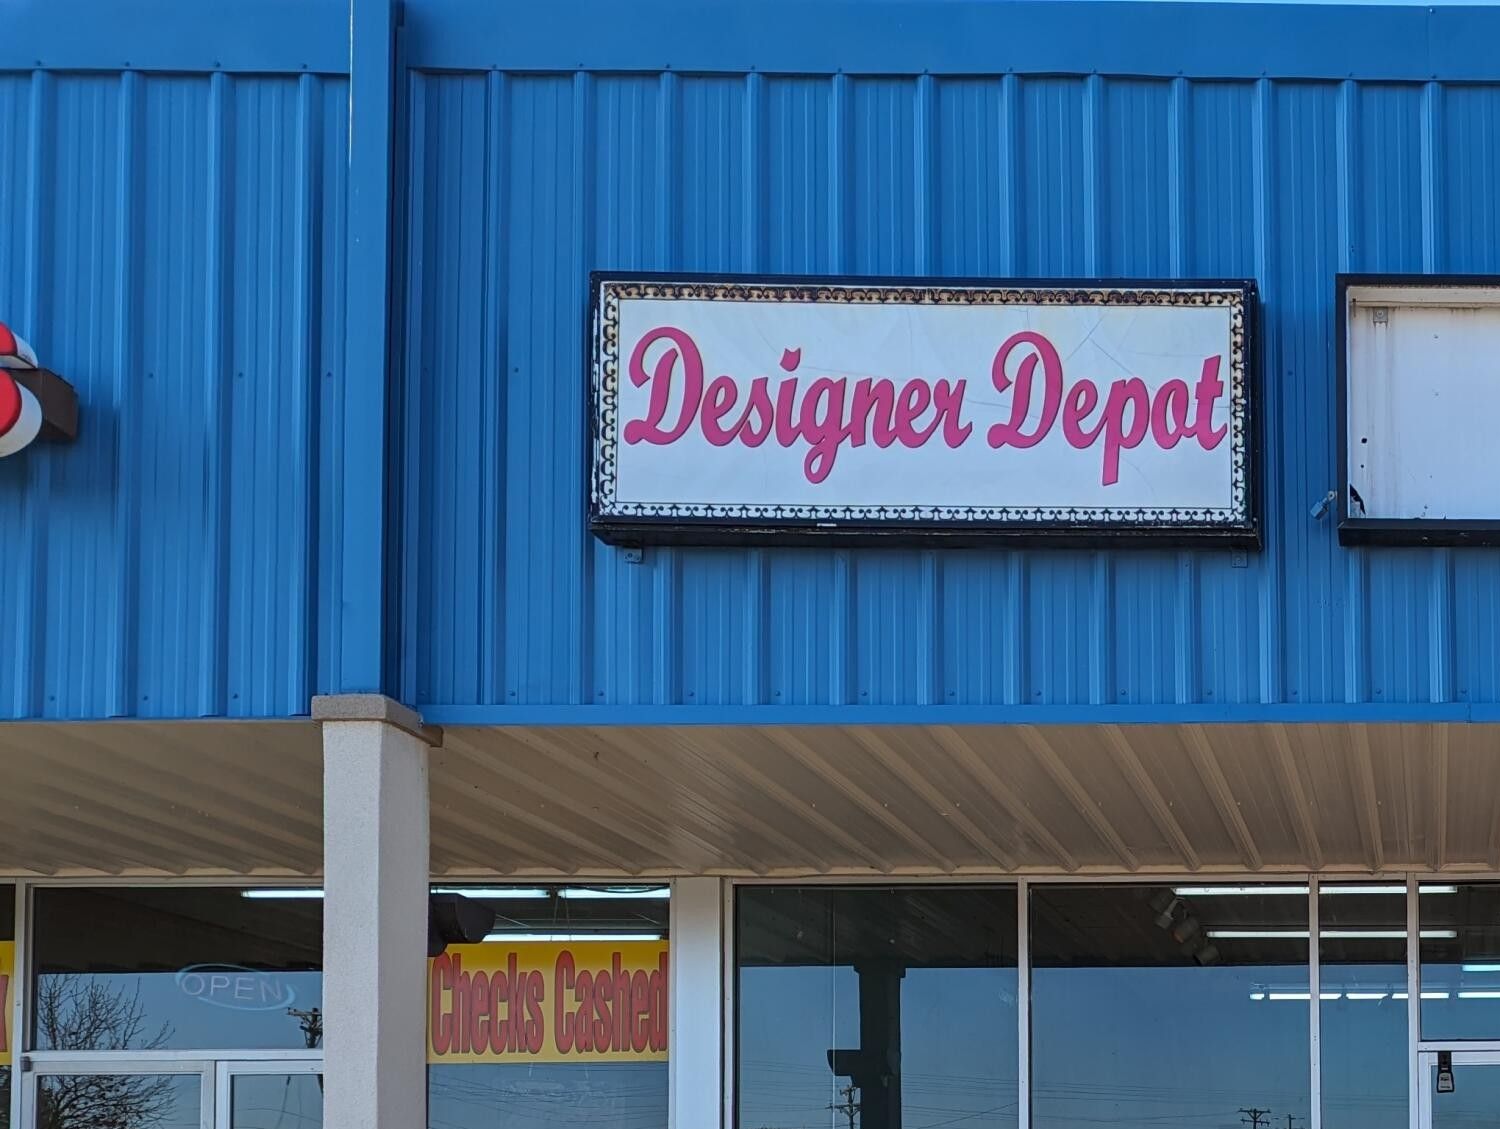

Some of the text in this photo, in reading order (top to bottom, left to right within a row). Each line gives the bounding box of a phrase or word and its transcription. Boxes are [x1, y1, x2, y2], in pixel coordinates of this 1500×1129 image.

[624, 326, 1228, 487] Designer Depot
[181, 973, 283, 1003] OPEN
[431, 950, 668, 1056] Checks Cashed
